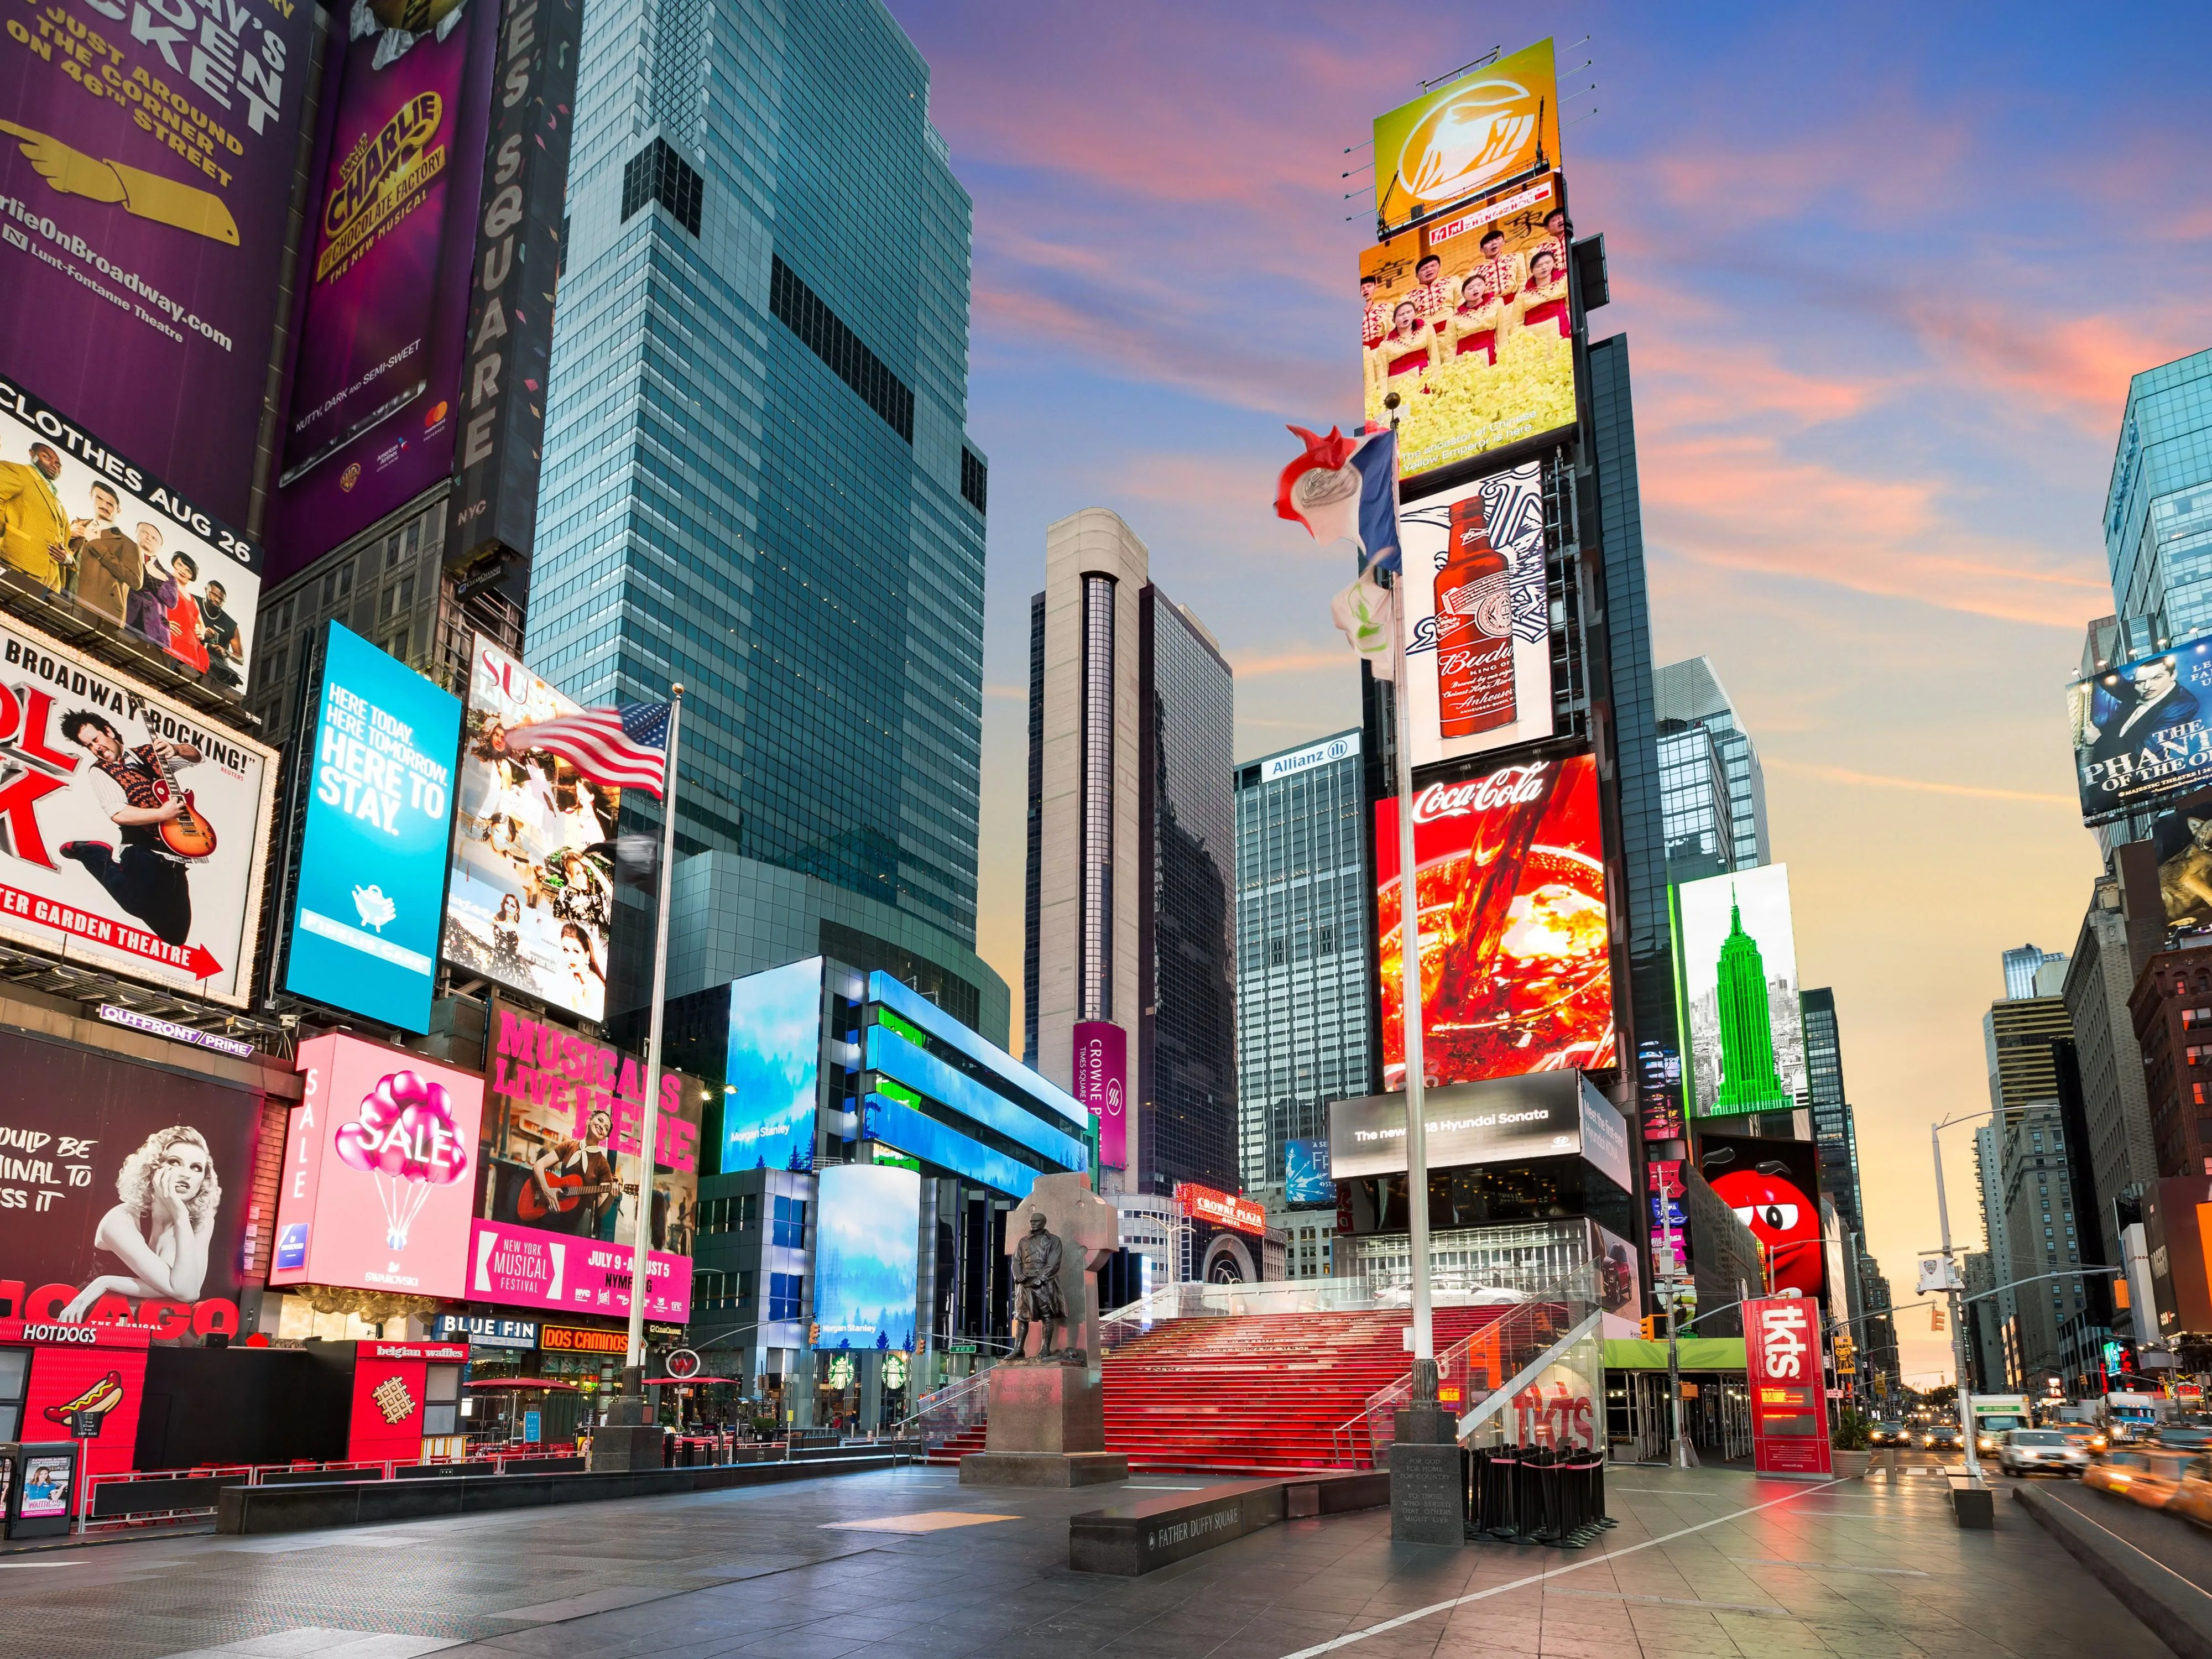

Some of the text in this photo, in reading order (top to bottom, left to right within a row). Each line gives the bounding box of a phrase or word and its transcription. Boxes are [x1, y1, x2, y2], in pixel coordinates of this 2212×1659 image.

[6, 19, 52, 62] ON
[133, 109, 232, 188] STREET
[36, 14, 215, 156] THE CORNER
[46, 7, 244, 156] JUST AROUND
[327, 94, 436, 231] CHARLIE
[332, 149, 443, 263] CHOCOLATE FACTORY
[330, 258, 348, 284] THE
[350, 234, 375, 267] NEW
[378, 189, 427, 241] MUSICAL
[31, 242, 131, 311] Lunt-Fontanne
[134, 303, 184, 343] Theatre
[295, 406, 323, 433] NUTTY,
[324, 387, 348, 413] DARK
[362, 338, 421, 385] SEMI-SWEET
[1402, 410, 1537, 462] The ancestor of Chinese
[1403, 422, 1536, 472] Yellow Emperor is here.
[149, 487, 212, 538] AUG
[218, 530, 251, 563] 26
[457, 499, 488, 527] NYC
[4, 638, 139, 721] BROADWAY
[1470, 665, 1498, 676] KING
[328, 681, 414, 747] HERE TODAY.
[2152, 719, 2205, 744] THE
[326, 702, 448, 787] HERE TOMORROW.
[1272, 749, 1324, 775] Allianz
[221, 766, 244, 781] REUTERS
[321, 724, 446, 820] HERE TO
[1412, 761, 1551, 824] Coca-Cola
[2101, 773, 2133, 792] OF
[2135, 758, 2186, 781] THE
[2125, 781, 2161, 797] MAJESTIC
[317, 765, 402, 837] STAY.
[35, 900, 112, 941] GARDEN
[117, 926, 192, 967] THEATRE
[102, 1006, 249, 1056] OUTFRONT PRIME
[493, 1056, 570, 1113] LIVE
[1090, 1039, 1102, 1101] CROWNE
[56, 1136, 99, 1159] BE
[294, 1068, 318, 1199] SALE
[357, 1112, 454, 1168] SALE
[731, 1124, 790, 1143] Morgan Stanley
[1355, 1109, 1550, 1142] The new Hyundai Sonata
[1584, 1099, 1624, 1149] Meet the first-ever
[1585, 1120, 1605, 1151] Hyundai
[65, 1164, 93, 1187] TO
[1197, 1197, 1262, 1225] CROWNE PLAZA
[494, 1251, 547, 1280] MUSICAL
[504, 1239, 542, 1257] NEW YORK
[588, 1250, 670, 1277] JULY 9 5
[364, 1271, 419, 1287] SWAROVSKI
[500, 1277, 539, 1293] FESTIVAL
[444, 1315, 534, 1338] BLUE FIN
[545, 1329, 629, 1352] DOS CAMINOS
[822, 1324, 877, 1334] Morgan Stanley
[1761, 1305, 1807, 1379] tkts
[377, 1345, 463, 1359] belgian waffles
[672, 1358, 695, 1373] W
[1159, 1508, 1238, 1548] FATHER DUFFY SQUARE
